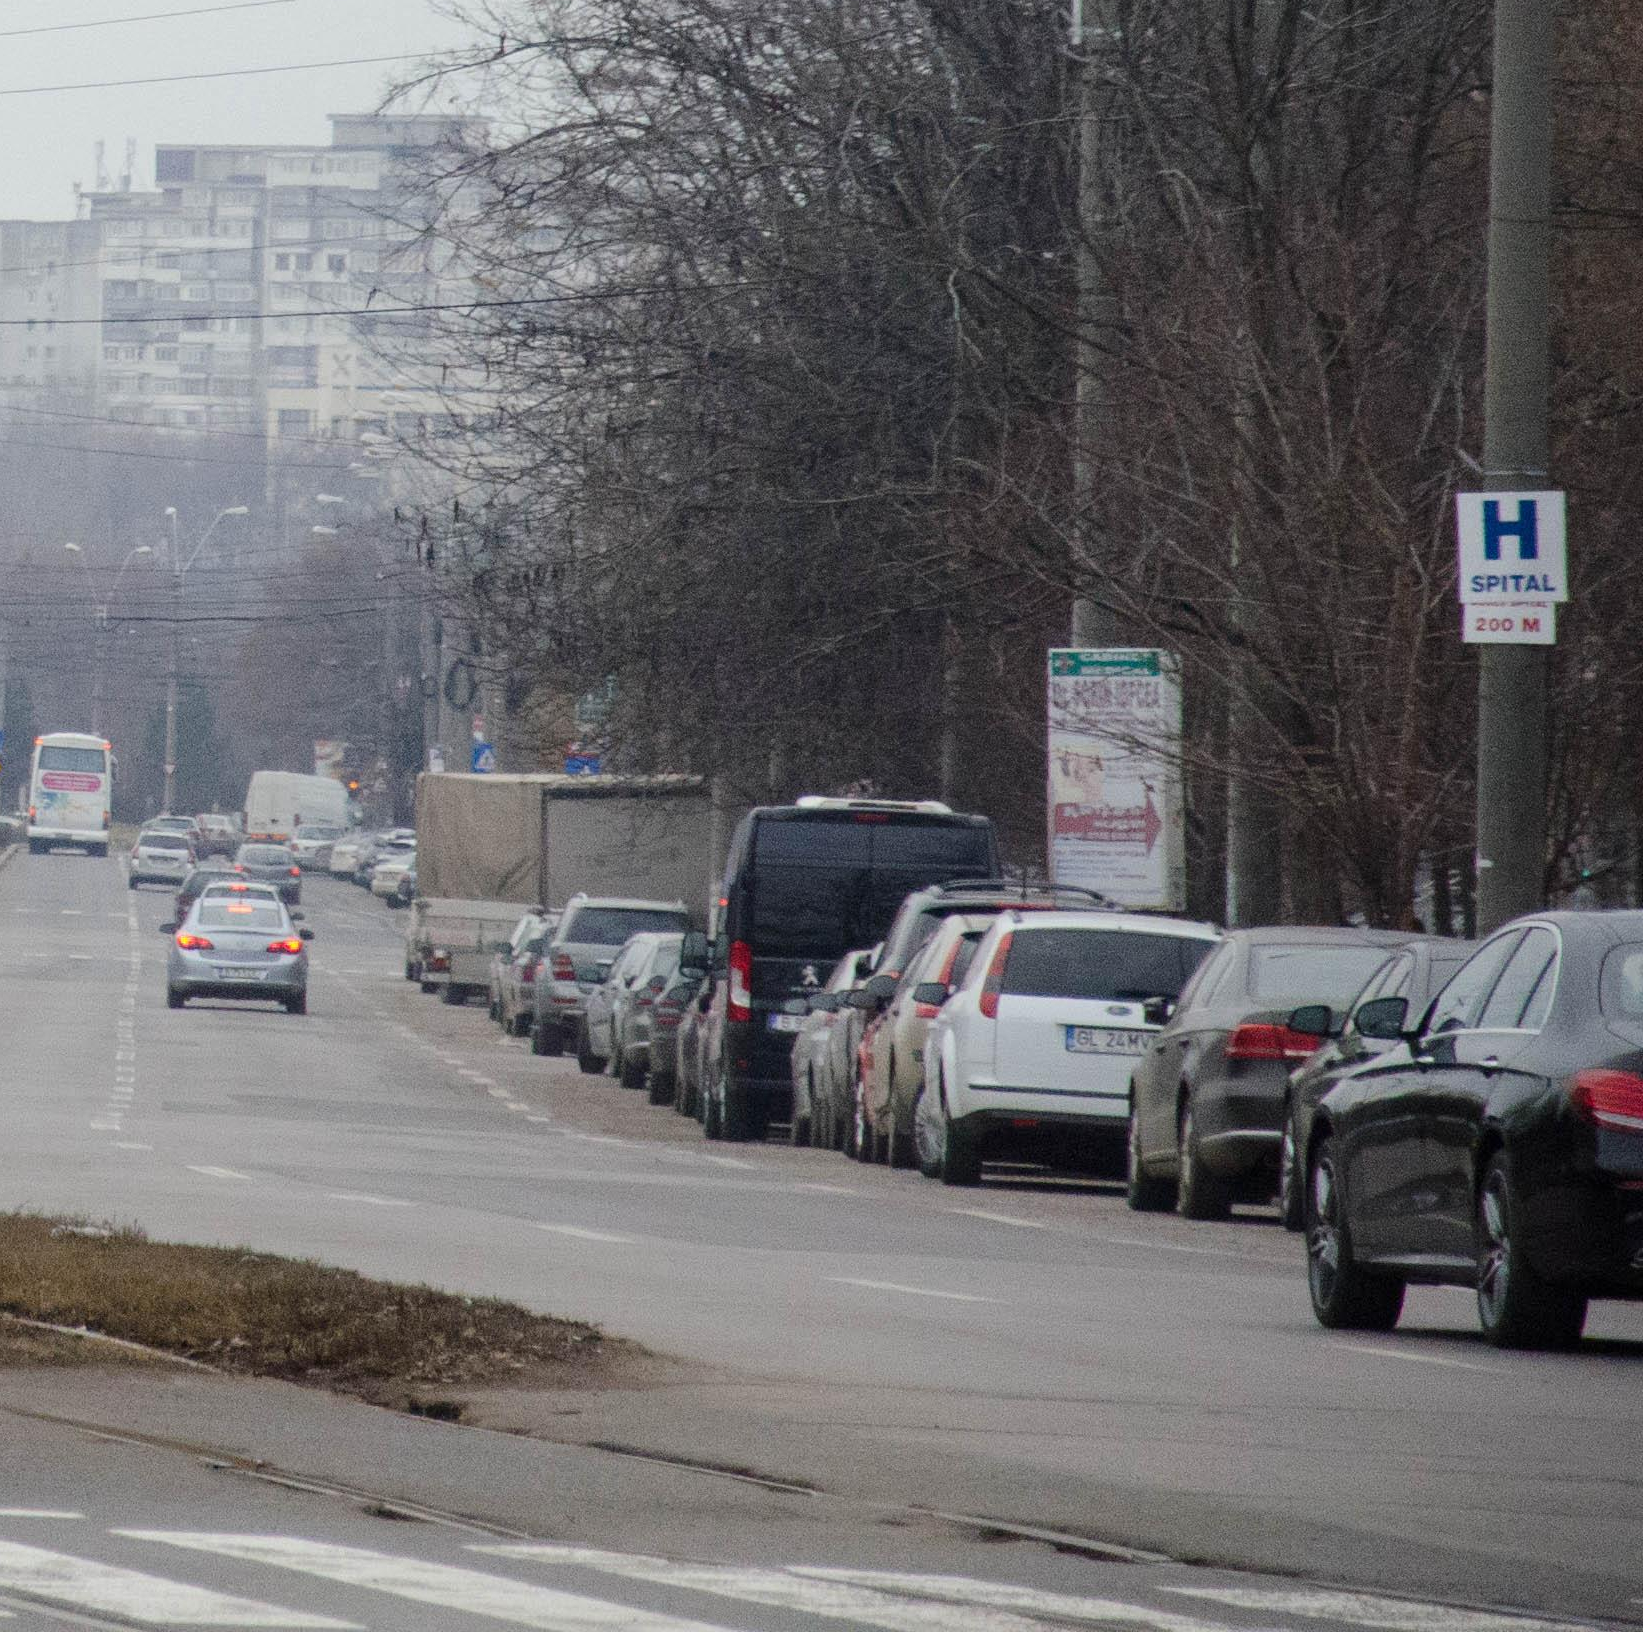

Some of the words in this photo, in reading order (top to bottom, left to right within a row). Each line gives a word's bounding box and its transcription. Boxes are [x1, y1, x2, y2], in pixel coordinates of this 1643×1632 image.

[1482, 499, 1538, 560] H
[1471, 574, 1556, 593] SPITAL
[1475, 618, 1514, 632] 200
[1521, 618, 1541, 633] M
